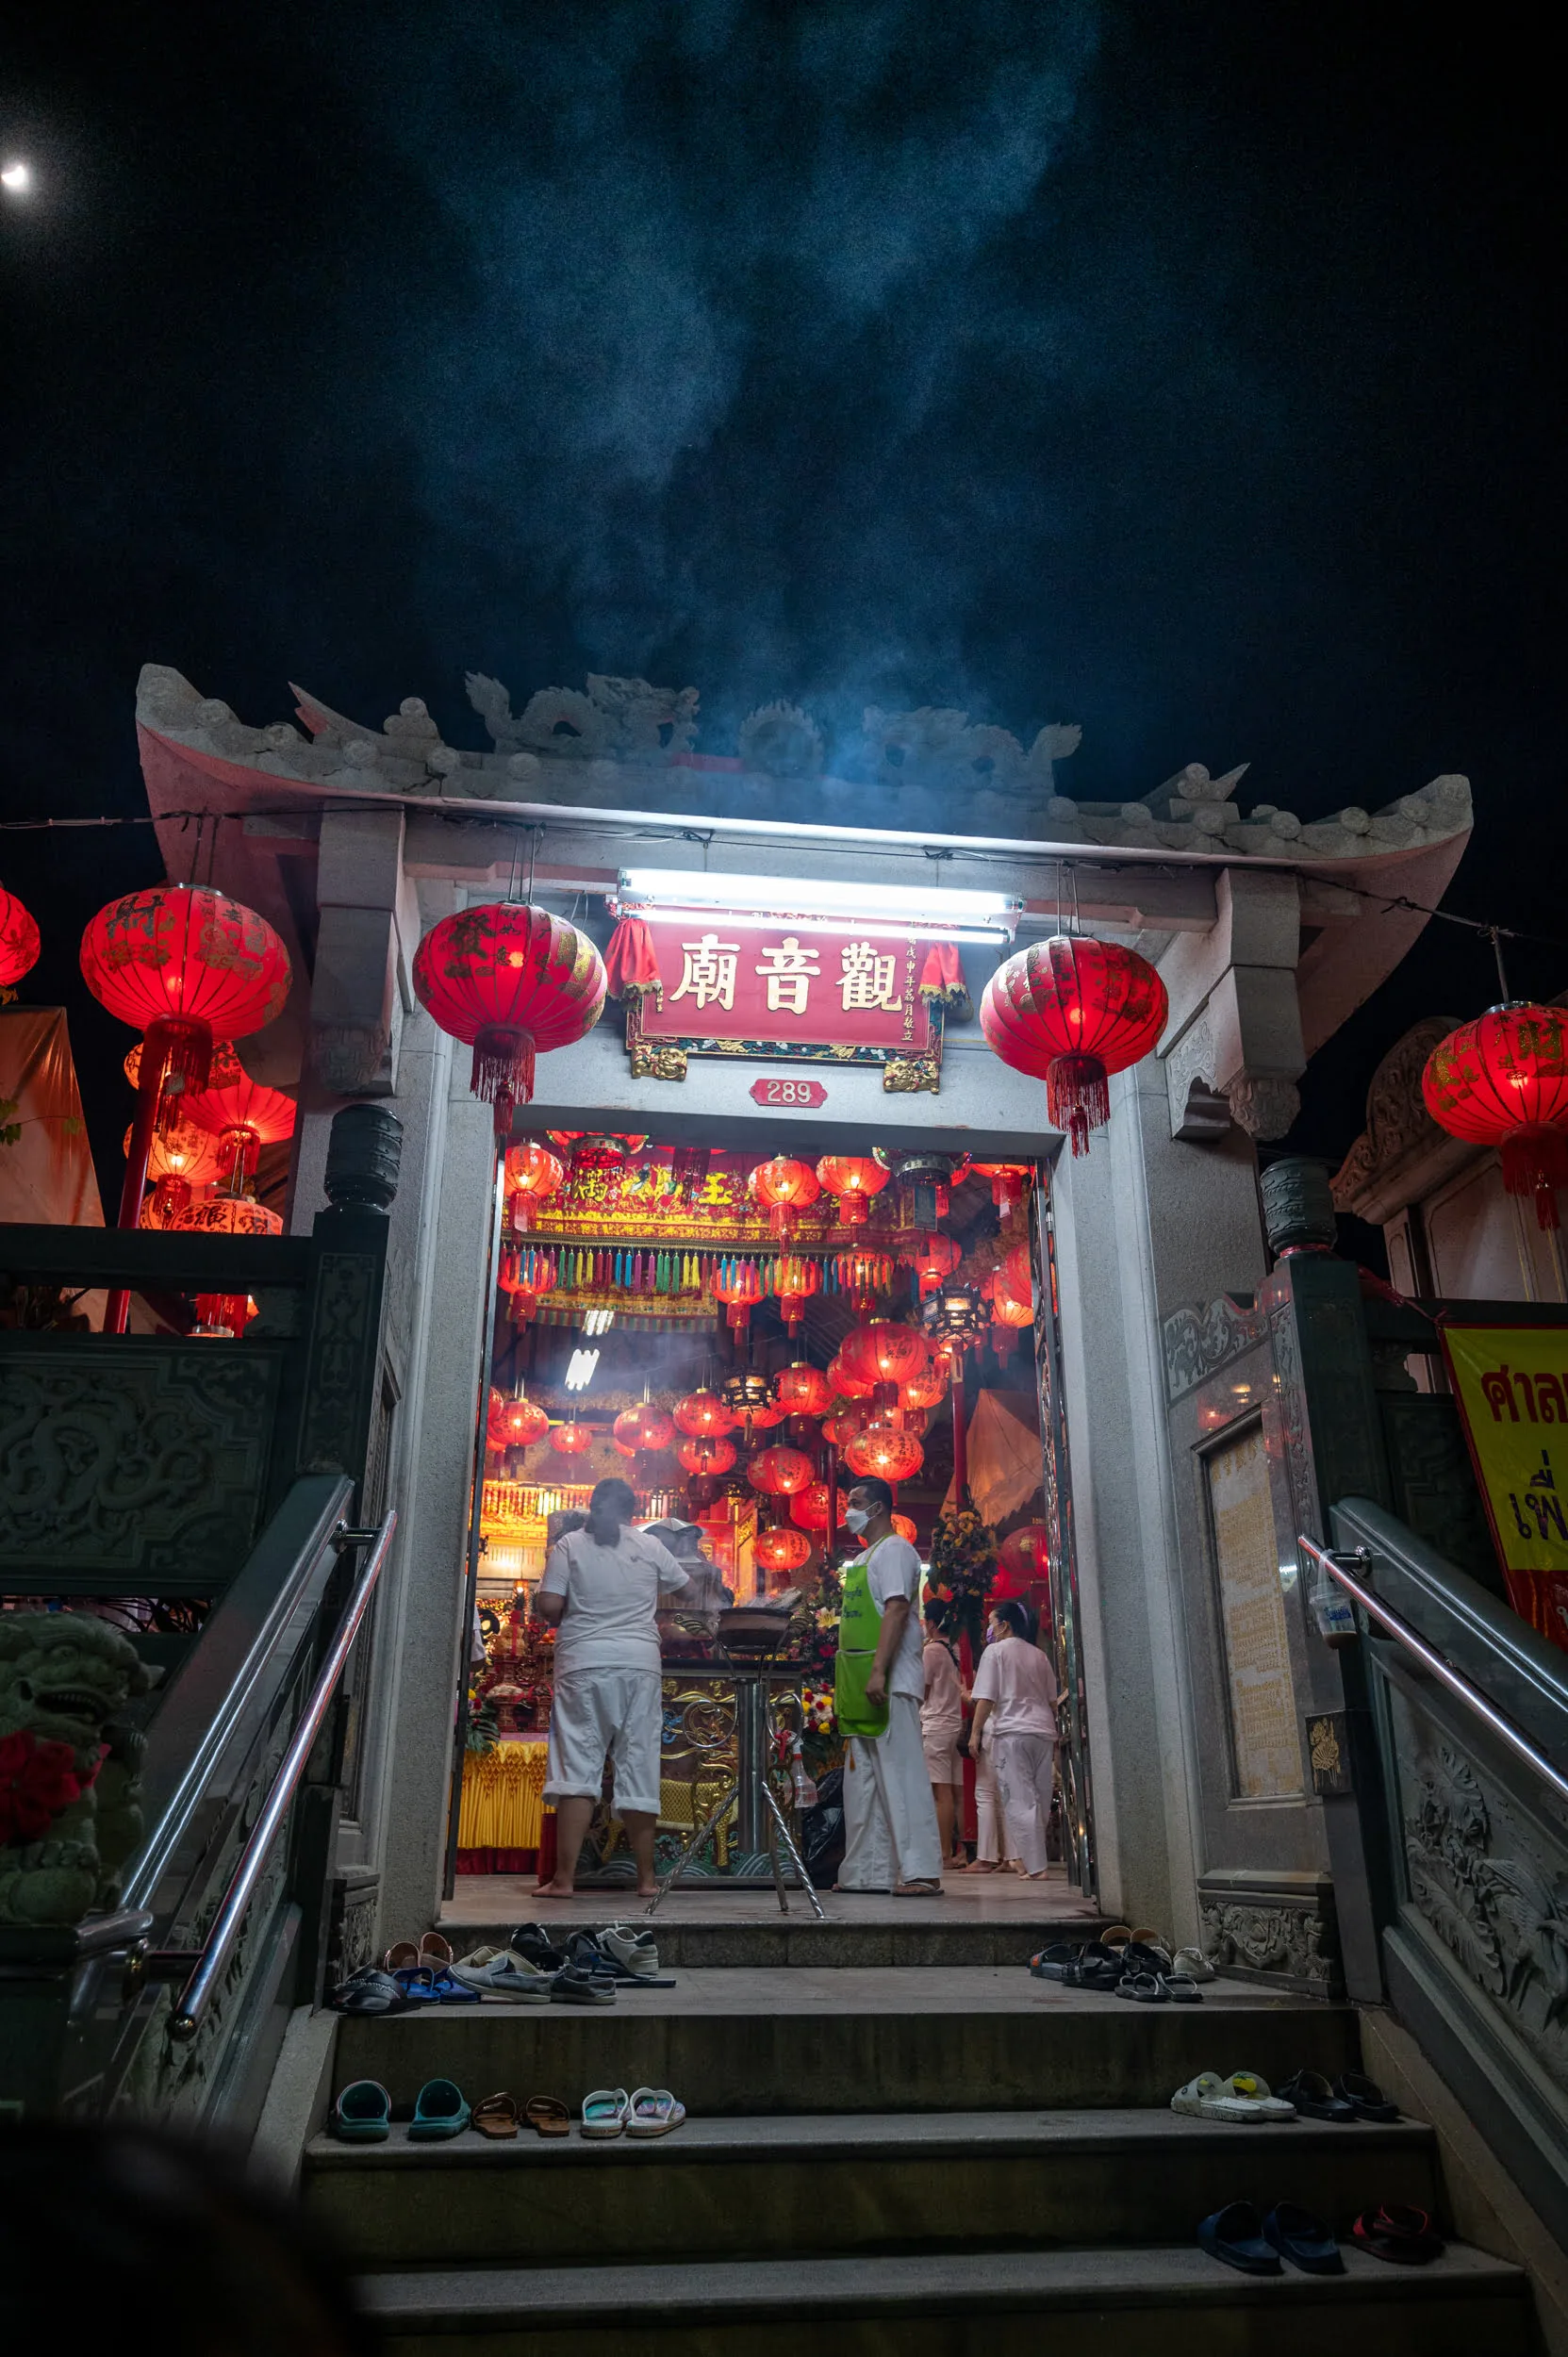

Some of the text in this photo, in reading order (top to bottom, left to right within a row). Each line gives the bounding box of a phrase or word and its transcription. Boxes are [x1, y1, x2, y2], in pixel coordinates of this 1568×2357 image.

[766, 1081, 812, 1104] 289
[1481, 1364, 1568, 1424] ศาล
[1509, 1449, 1568, 1541] เพื่
